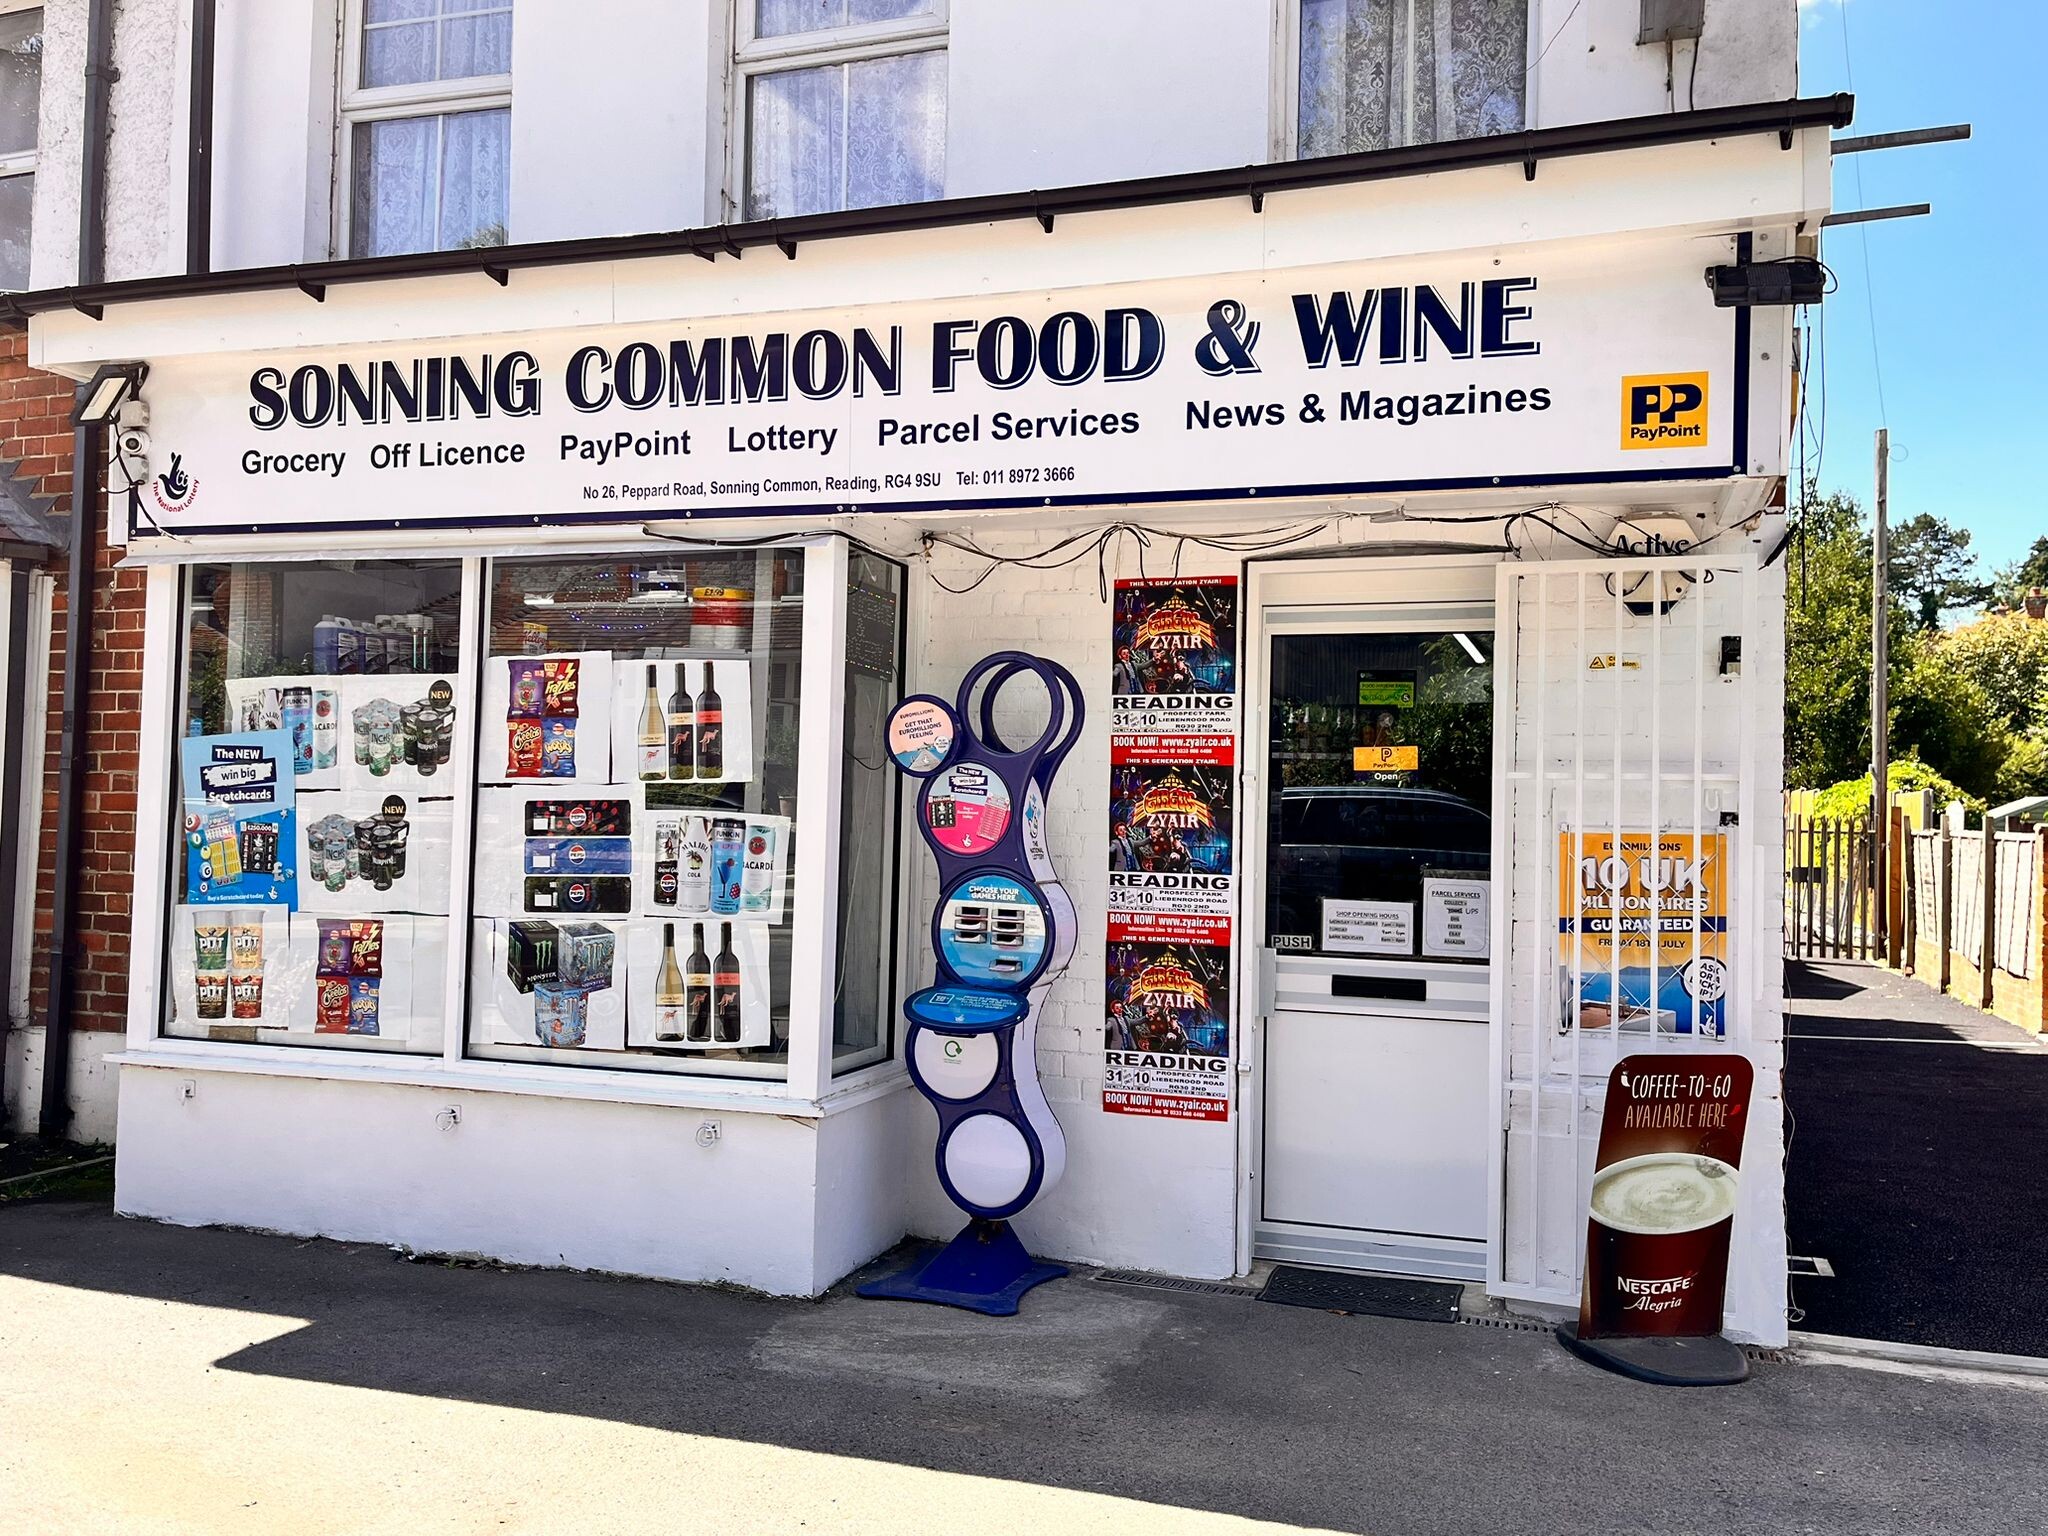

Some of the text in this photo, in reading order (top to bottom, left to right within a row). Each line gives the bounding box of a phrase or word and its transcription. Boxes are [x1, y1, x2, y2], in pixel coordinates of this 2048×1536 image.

[249, 277, 1541, 430] SONNING COMMON FOOD & WINE
[241, 383, 1552, 477] Grocery Off Licence PayPoint Lottery Parcel Services News & Magazines
[1630, 422, 1701, 442] PayPoint
[583, 466, 1075, 502] No 26, Peppard Road, Sonning Common, Reading, RG4 9SU Tel: 011 8972 3666
[157, 496, 185, 513] National
[183, 479, 200, 508] Lottery
[1150, 635, 1203, 649] ZYAIR
[431, 691, 450, 699] NEW
[1113, 696, 1233, 710] READING
[900, 709, 934, 719] EUROMILLIONS
[1113, 714, 1129, 725] 31
[1141, 714, 1156, 725] 10
[899, 722, 942, 736] EUROMILLIONS
[909, 731, 934, 739] FEELING
[1113, 736, 1232, 748] BOOK NOW! www.zyair.co.uk
[215, 749, 260, 760] The NEW
[220, 768, 257, 781] win big
[1374, 773, 1398, 781] Open
[208, 789, 272, 802] Scratchcards
[384, 805, 404, 814] NEW
[1147, 814, 1199, 829] ZYAIR
[1109, 873, 1230, 890] READING
[1639, 857, 1710, 893] UK
[969, 886, 1019, 895] CHOOSE YOUR
[971, 892, 1016, 901] GAMES HERE
[1110, 891, 1125, 902] 31
[1137, 892, 1153, 904] 10
[1109, 913, 1229, 929] BOOK NOW! www.zyair.co.uk
[199, 937, 224, 949] POT
[234, 937, 259, 948] POT
[1273, 936, 1310, 948] PUSH
[1661, 941, 1686, 949] JULY
[199, 986, 224, 998] POT
[234, 985, 260, 997] POT
[1143, 992, 1196, 1009] ZYAIR
[1105, 1052, 1227, 1073] READING
[1106, 1070, 1122, 1081] 31
[1134, 1072, 1150, 1084] 10
[1632, 1074, 1731, 1099] COFFEE-TO-GO
[1105, 1092, 1225, 1112] BOOK NOW! www.zyair.co.uk
[1625, 1103, 1728, 1129] AVAILABLE HERE
[1623, 1296, 1682, 1313] Alegria
